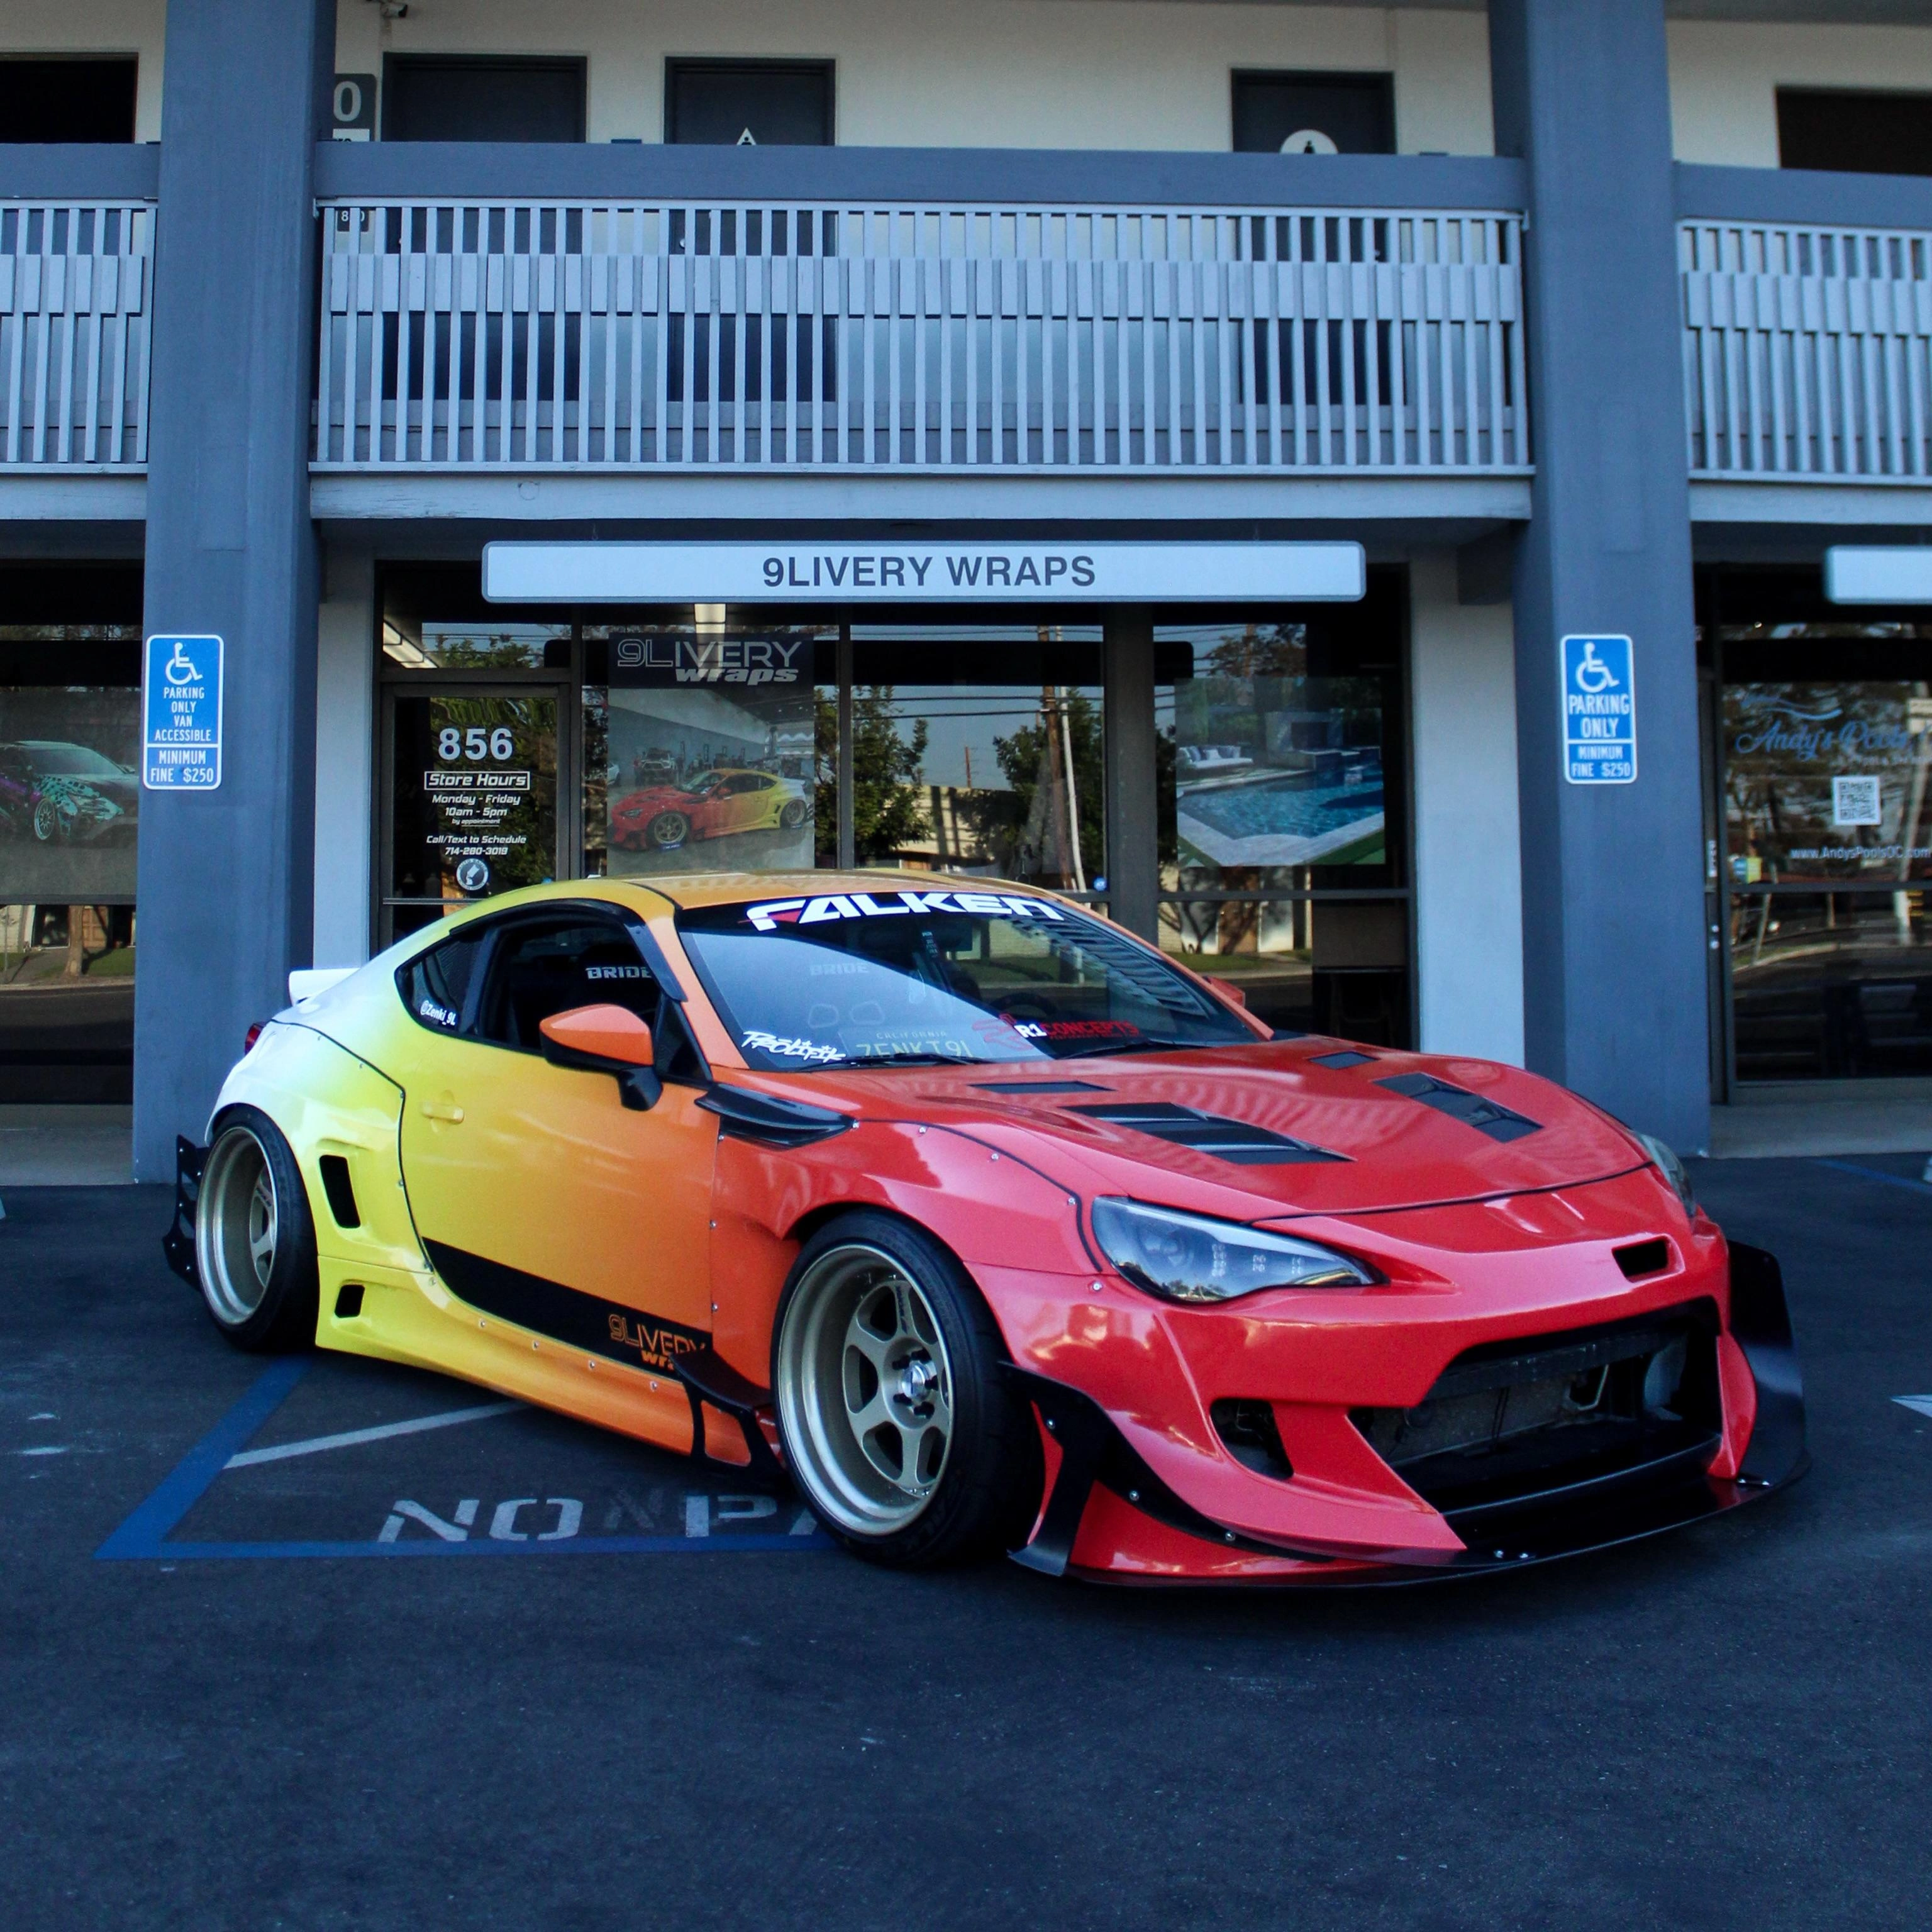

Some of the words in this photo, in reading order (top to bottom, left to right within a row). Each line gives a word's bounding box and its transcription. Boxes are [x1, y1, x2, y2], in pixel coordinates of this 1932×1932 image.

[762, 557, 933, 587] 9LIVERY
[946, 556, 1096, 587] WRAPS
[618, 639, 802, 667] 9LIVERY
[675, 669, 799, 686] wraps
[164, 687, 205, 699] PARKING
[171, 701, 197, 713] ONLY
[1568, 694, 1630, 714] PARKING
[174, 715, 192, 727] VAN
[1580, 717, 1619, 738] ONLY
[154, 730, 212, 741] ACCESSIBLE
[1735, 720, 1834, 762] Andy's
[438, 728, 513, 760] 856
[158, 750, 206, 765] MINIMUM
[1578, 746, 1623, 760] MINIMUM
[150, 768, 174, 782] FINE
[183, 767, 214, 783] $250
[1571, 762, 1594, 777] FINE
[1601, 762, 1631, 777] $250
[429, 774, 473, 786] Store
[476, 774, 526, 786] Hours
[432, 794, 476, 806] Monday
[485, 794, 521, 806] Friday
[445, 807, 473, 816] 10am
[482, 808, 508, 818] 5pm
[426, 835, 468, 844] Call/Text
[469, 836, 480, 844] to
[482, 835, 527, 844] Schedule
[747, 892, 1065, 931] FALKEN
[586, 967, 652, 979] BRIDE
[876, 1031, 947, 1040] CALIFORNIA
[377, 1497, 584, 1543] NO
